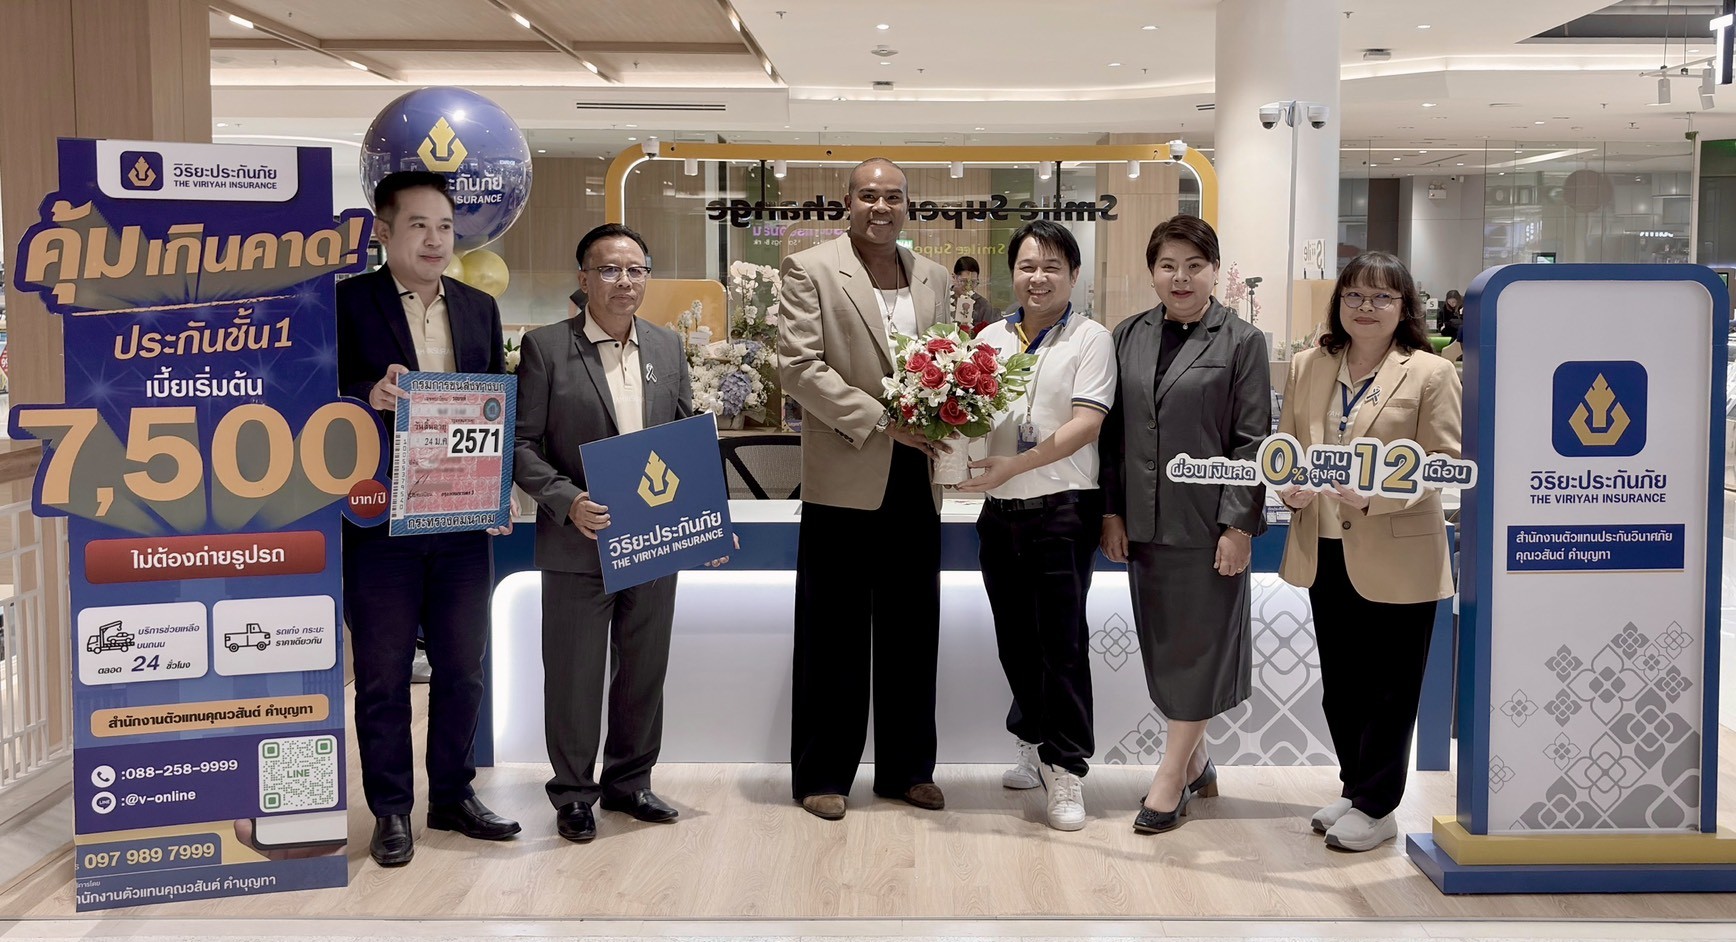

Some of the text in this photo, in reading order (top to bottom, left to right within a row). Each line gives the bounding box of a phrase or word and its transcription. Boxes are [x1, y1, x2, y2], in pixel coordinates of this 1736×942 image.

[173, 162, 277, 180] วิริยะประกันภัย
[174, 180, 277, 190] THE VIRIYAH INSURANCE
[25, 200, 364, 304] คุ้ม เกินคาด!
[146, 366, 263, 398] เบี้ยเริ่มต้น
[451, 428, 500, 454] 2571
[18, 401, 381, 517] 7,500
[1312, 450, 1348, 466] นาน
[1354, 443, 1468, 491] 12 เดือน
[1171, 458, 1206, 478] ผ่อน
[1208, 461, 1256, 481] เงินสด
[1310, 468, 1346, 483] สูงสด
[1530, 469, 1667, 490] วิริยะประกันภัย
[351, 491, 387, 506] บาท/ปี
[1530, 493, 1666, 504] THE VIRIYAH INSURANCE
[608, 510, 722, 557] วิริยะประกันภัย
[1516, 530, 1673, 543] สำนักงานตัวแทนประกันวินาศภัย
[131, 545, 285, 571] ไม่ต้องถ่ายรูปรถ
[612, 528, 724, 570] THE VIRIYAH INSURANCE
[1516, 548, 1611, 563] คุณวสันต์ คำบุญทา
[138, 624, 200, 636] บริการช่วยเหลือ
[275, 637, 323, 647] ราคาเดียวกัน
[98, 654, 191, 675] ตลอด 24 ชั่วโมง
[108, 703, 314, 729] สำนักงานตัวแทนคุณวสันต์ คำบุญทา
[287, 768, 310, 780] LINE
[84, 842, 215, 869] 097 989 7999
[224, 875, 276, 891] คำบุญทา
